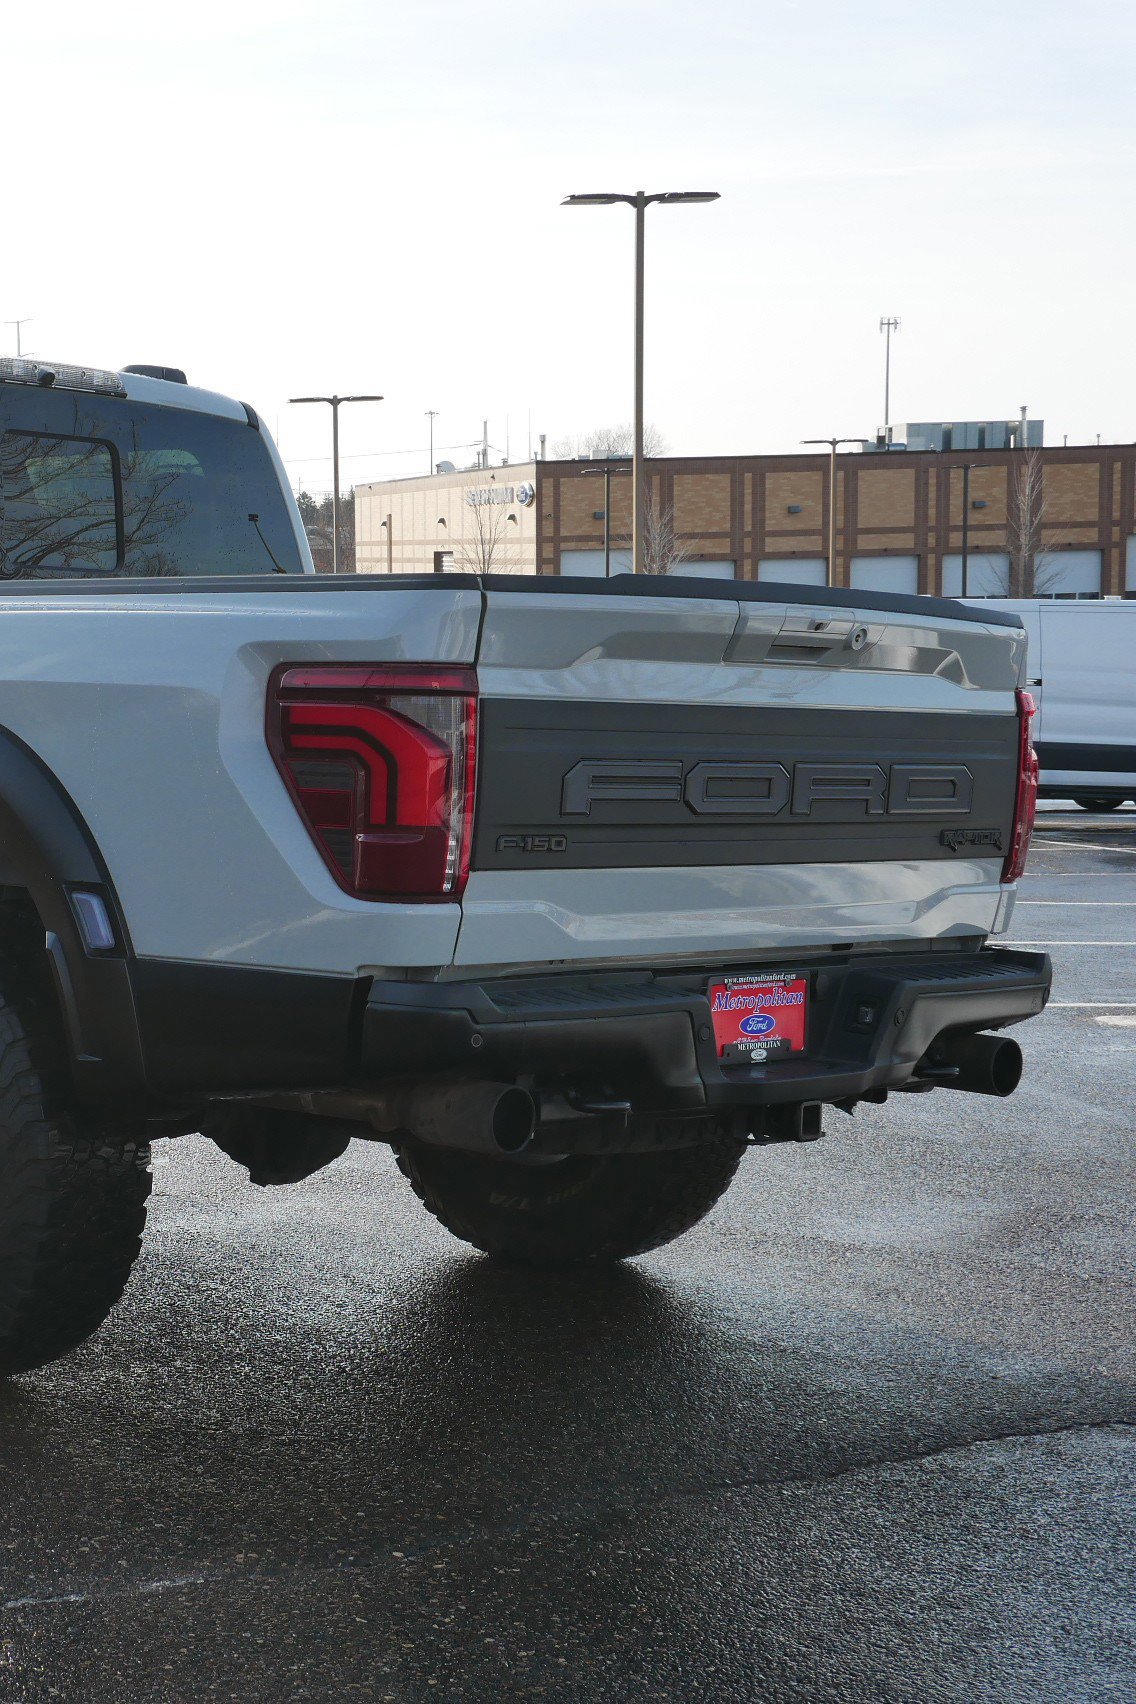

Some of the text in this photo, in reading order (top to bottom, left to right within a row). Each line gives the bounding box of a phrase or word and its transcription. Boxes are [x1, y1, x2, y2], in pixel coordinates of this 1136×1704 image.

[560, 758, 974, 816] FORD
[496, 834, 567, 852] F-150
[940, 828, 1003, 851] RAPTOR
[724, 973, 796, 984] www.metropolitanford.com
[712, 987, 804, 1013] Metropolitan
[746, 1017, 768, 1031] Ford
[738, 1040, 781, 1050] METROPOLITAN
